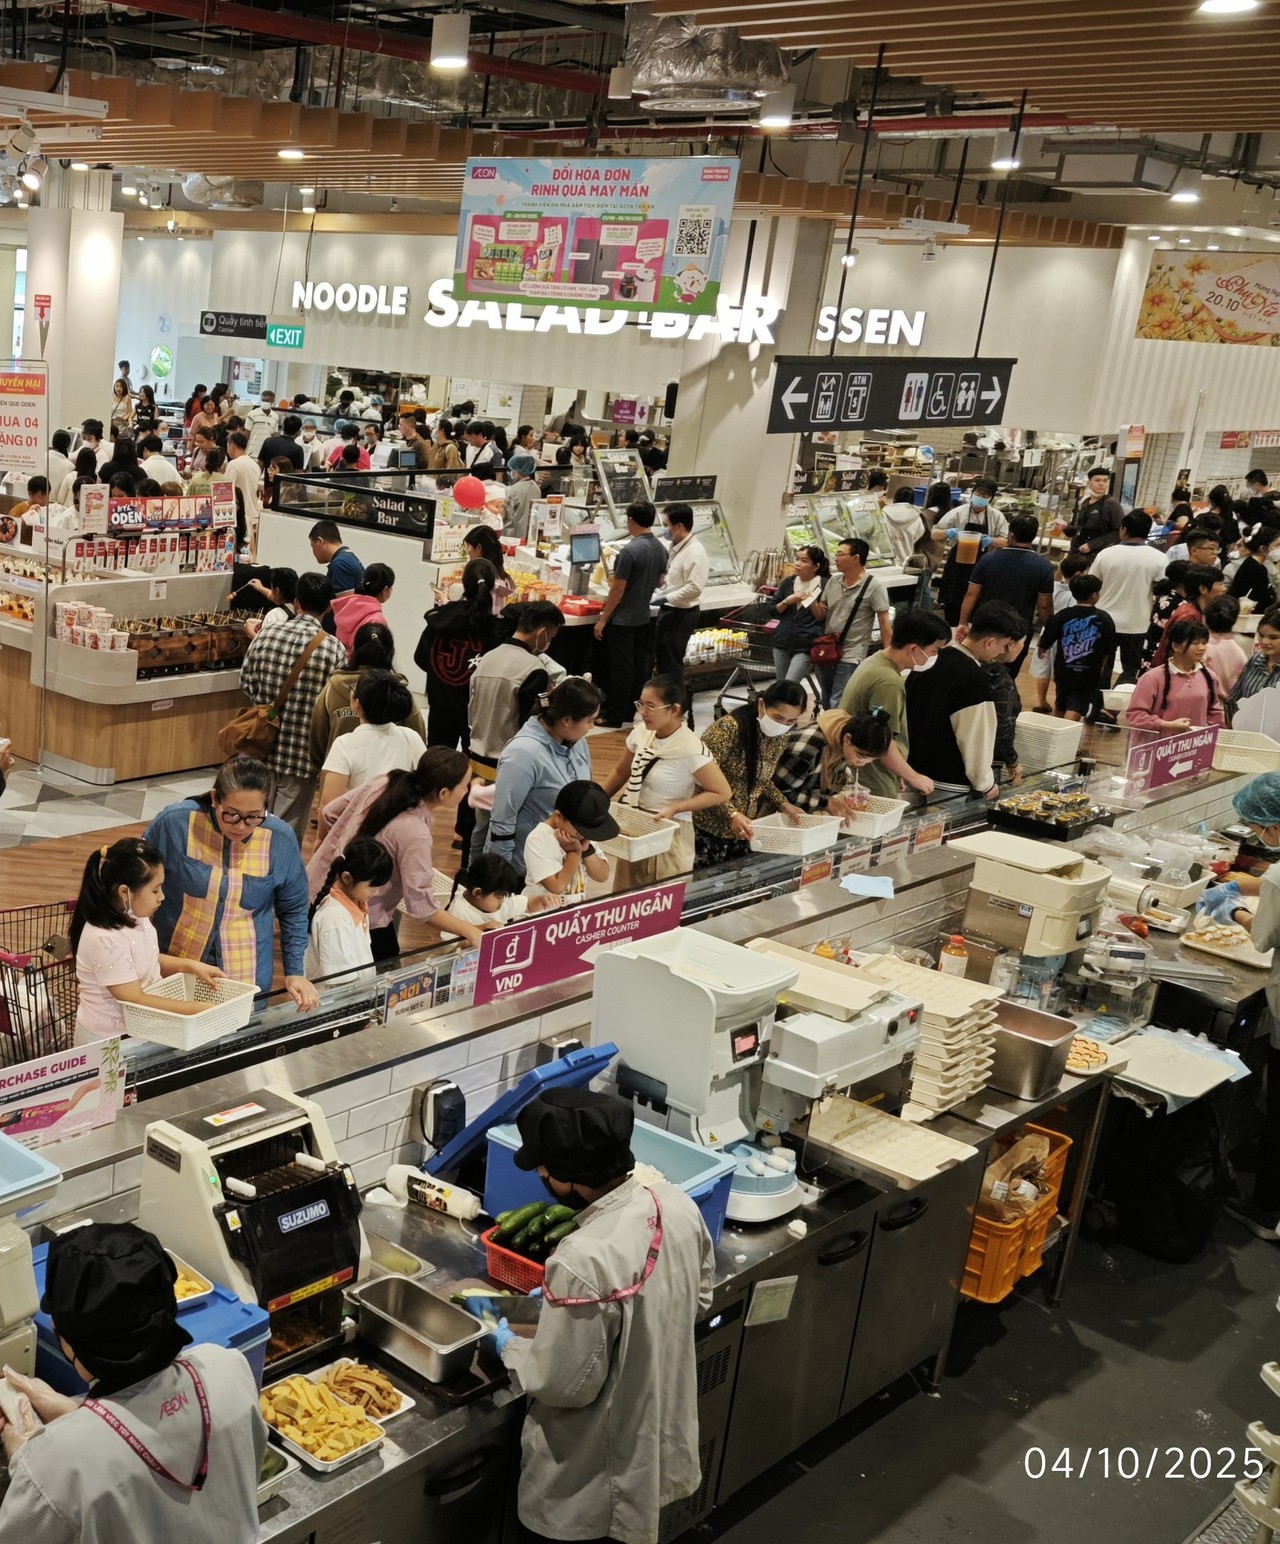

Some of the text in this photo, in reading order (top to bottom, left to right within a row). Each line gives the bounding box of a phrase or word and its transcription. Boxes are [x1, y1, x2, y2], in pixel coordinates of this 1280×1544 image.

[575, 166, 600, 180] HÓA
[531, 184, 559, 196] RINH
[589, 184, 617, 197] MAY
[292, 281, 408, 315] NOODLE
[1205, 291, 1240, 312] 20.10
[276, 328, 302, 345] EXIT
[24, 380, 41, 390] MẠI
[852, 375, 867, 385] ATM
[24, 417, 39, 428] 04
[26, 436, 38, 447] 01
[372, 496, 405, 512] Salad
[111, 512, 142, 525] ODEN
[377, 512, 399, 526] Bar
[1178, 737, 1192, 752] THU
[545, 892, 674, 946] QUẦY THU NGÂN
[575, 920, 640, 945] CASHIER COUNTER
[495, 972, 524, 993] VND
[51, 1055, 87, 1074] GUIDE
[281, 1203, 326, 1229] SUZUMO
